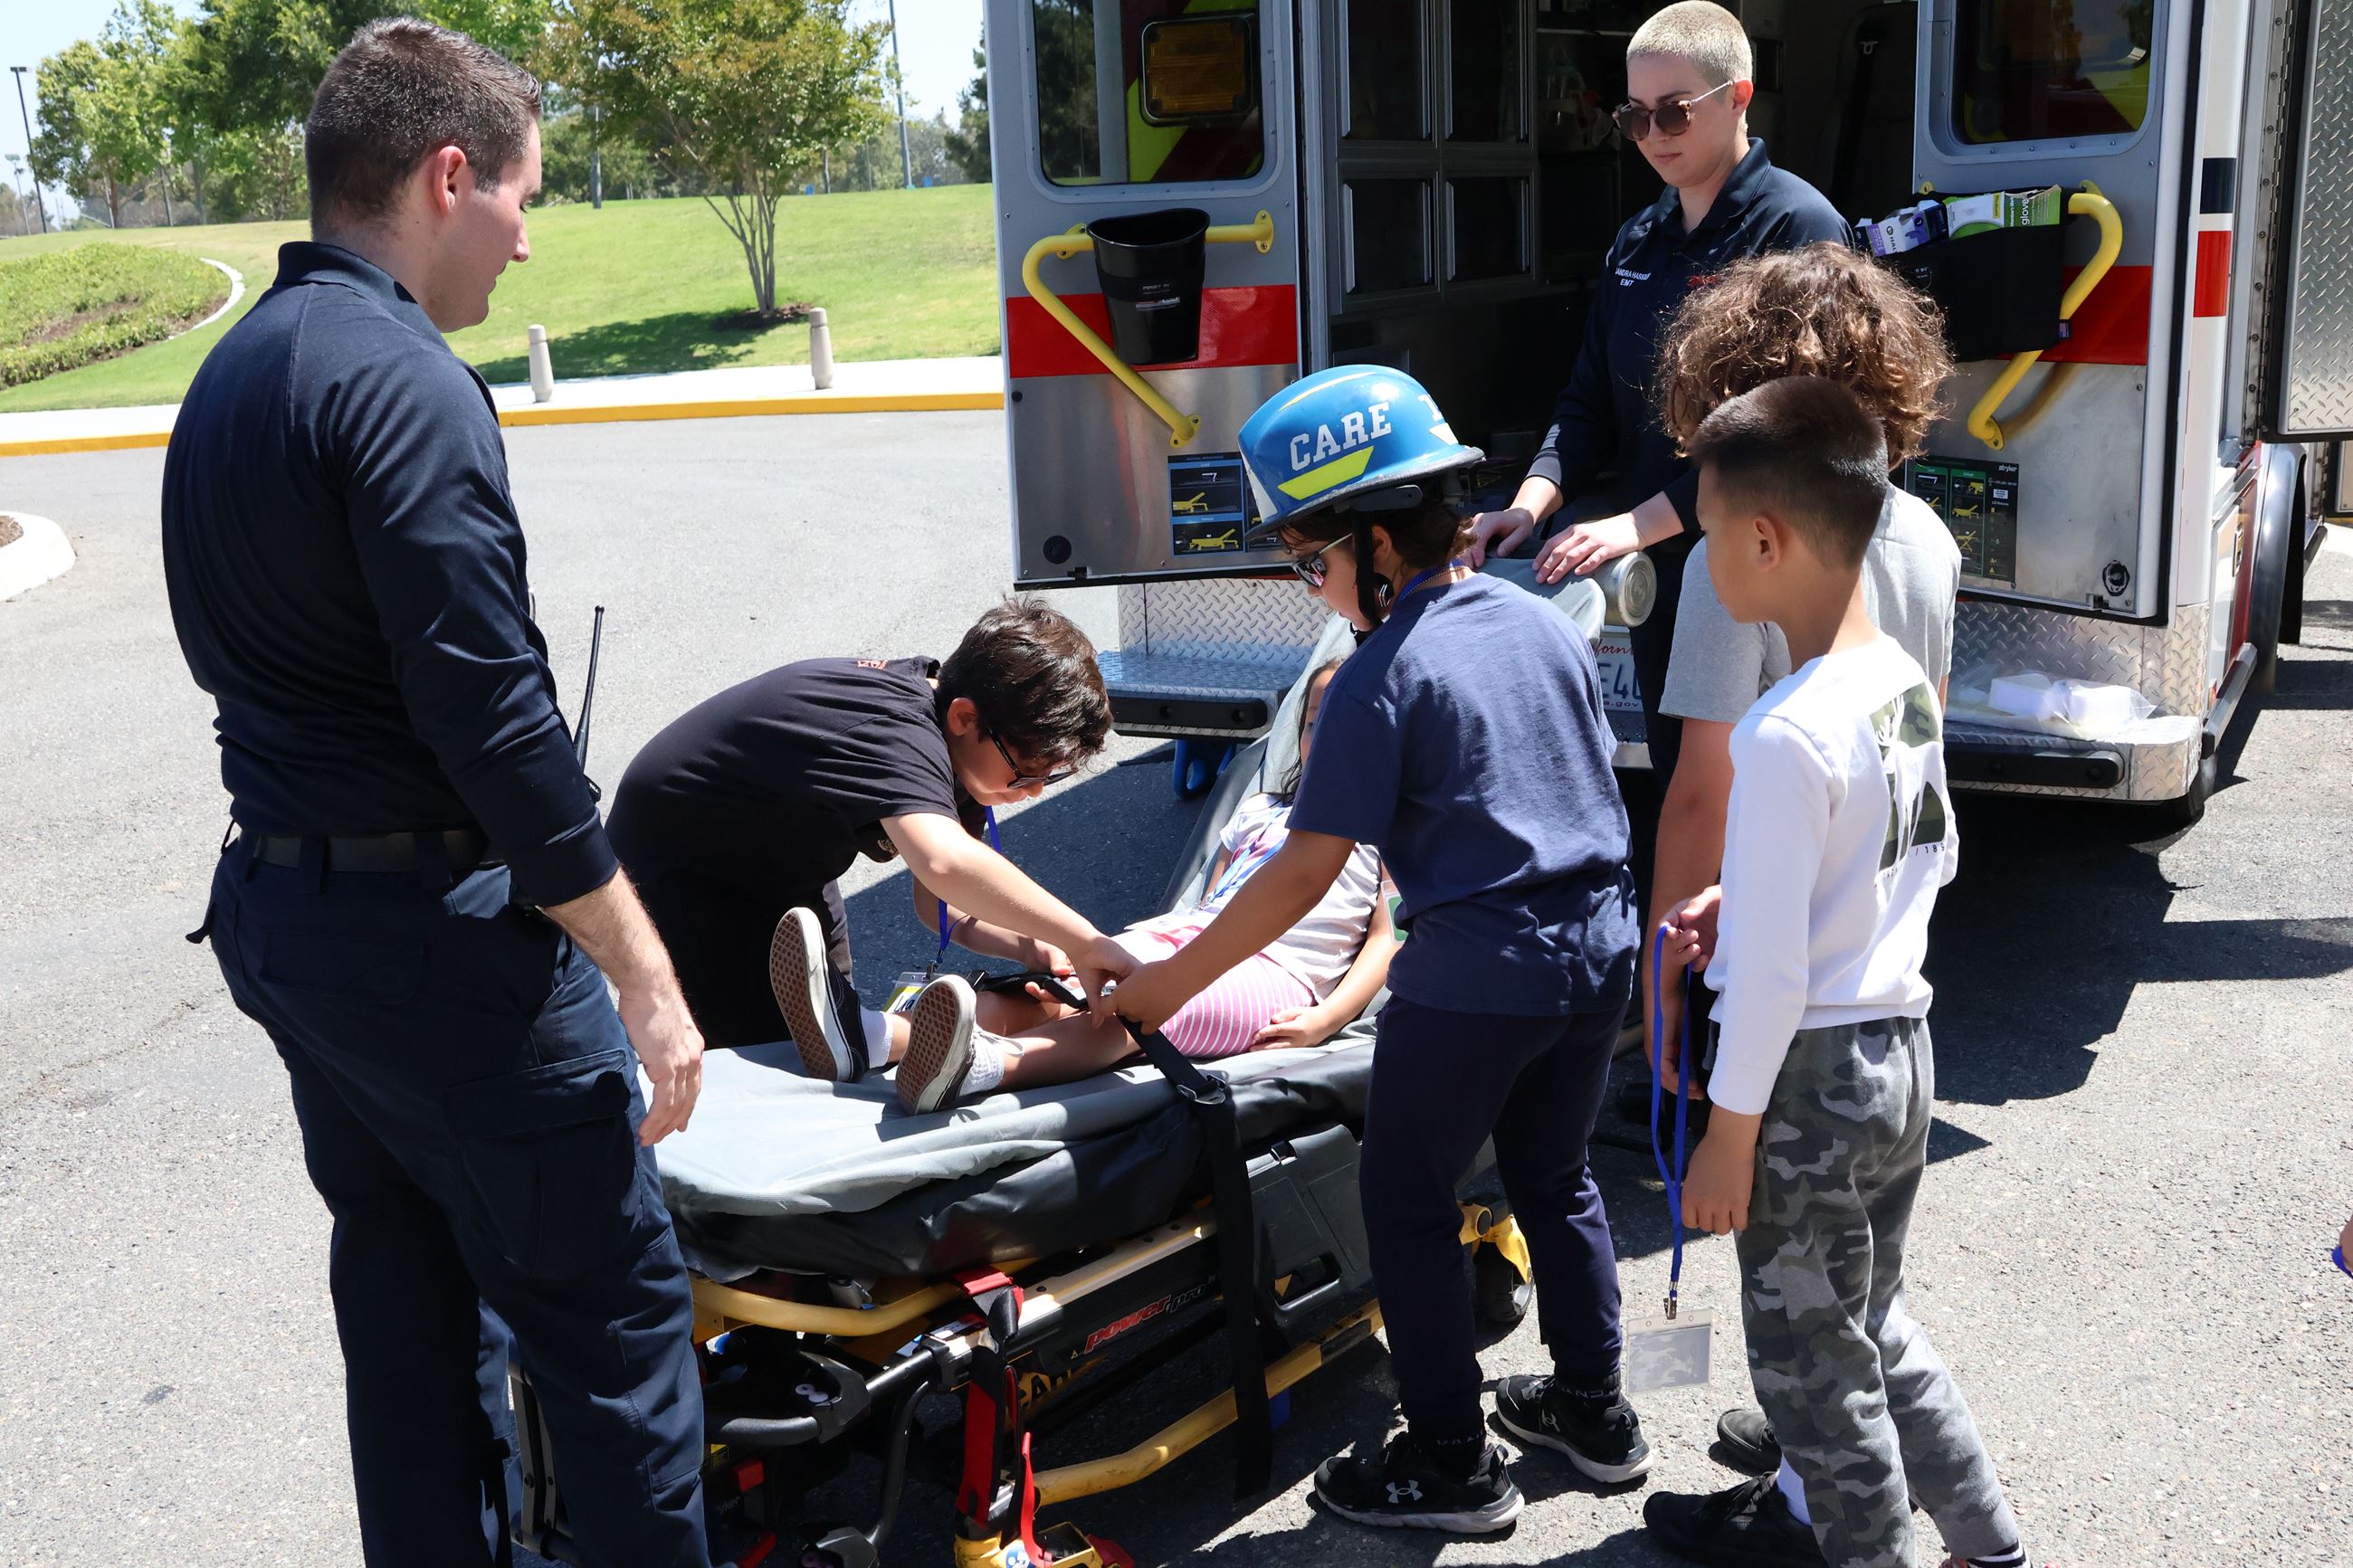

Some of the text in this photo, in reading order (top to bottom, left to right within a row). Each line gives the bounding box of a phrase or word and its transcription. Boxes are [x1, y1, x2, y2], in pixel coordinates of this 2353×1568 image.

[1620, 279, 1634, 287] EMT
[1290, 401, 1392, 471] CARE
[1925, 842, 1945, 854] 189
